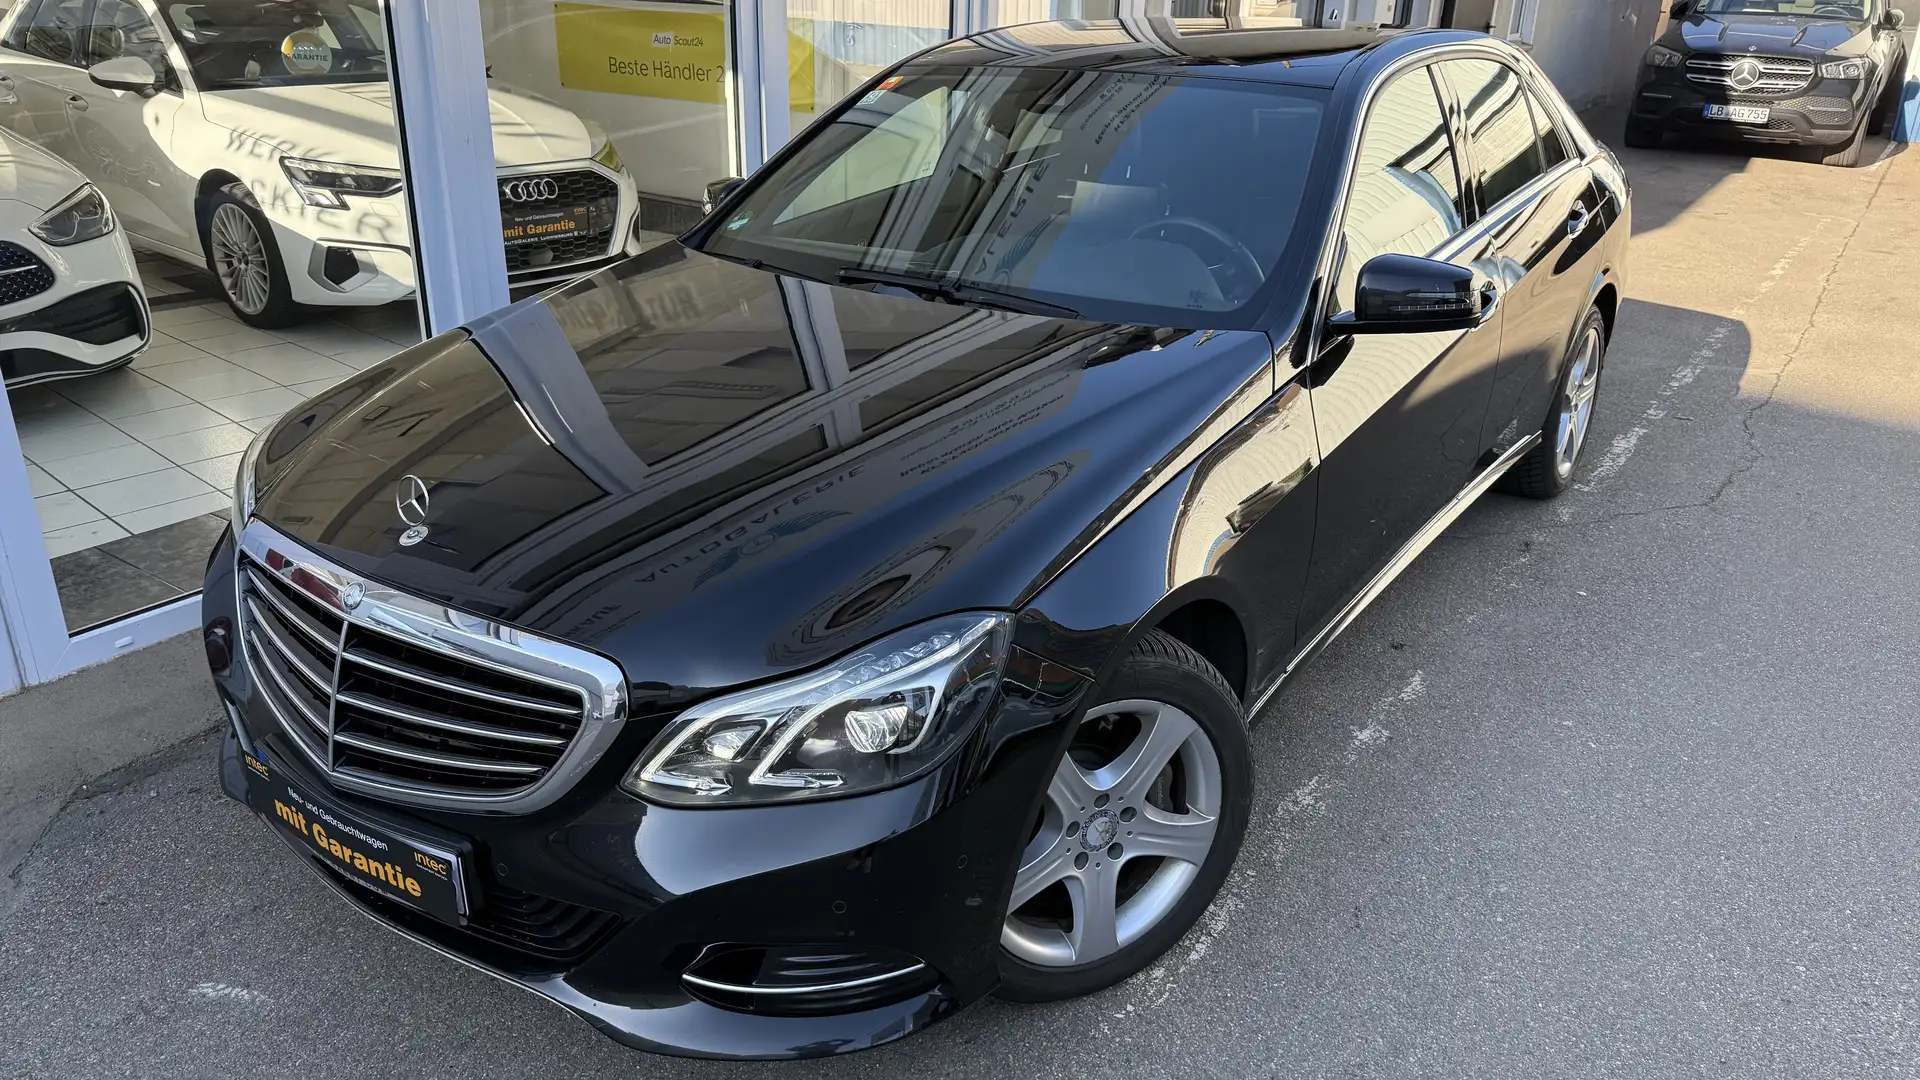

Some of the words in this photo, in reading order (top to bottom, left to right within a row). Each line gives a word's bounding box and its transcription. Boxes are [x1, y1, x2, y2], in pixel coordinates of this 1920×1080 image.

[653, 34, 671, 45] Auto
[673, 35, 704, 47] Scout24
[608, 56, 649, 77] Beste
[652, 59, 711, 82] Händler
[1709, 105, 1724, 116] LB
[1730, 107, 1745, 118] AG
[1747, 108, 1767, 120] 755
[504, 226, 524, 238] mit
[526, 219, 576, 235] Garantie
[244, 754, 270, 777] intec
[287, 785, 304, 804] Neu-
[305, 801, 319, 815] und
[319, 808, 389, 852] Gebrauchtwagen
[274, 798, 309, 837] mit
[312, 822, 422, 898] Garantie
[413, 850, 447, 876] intec
